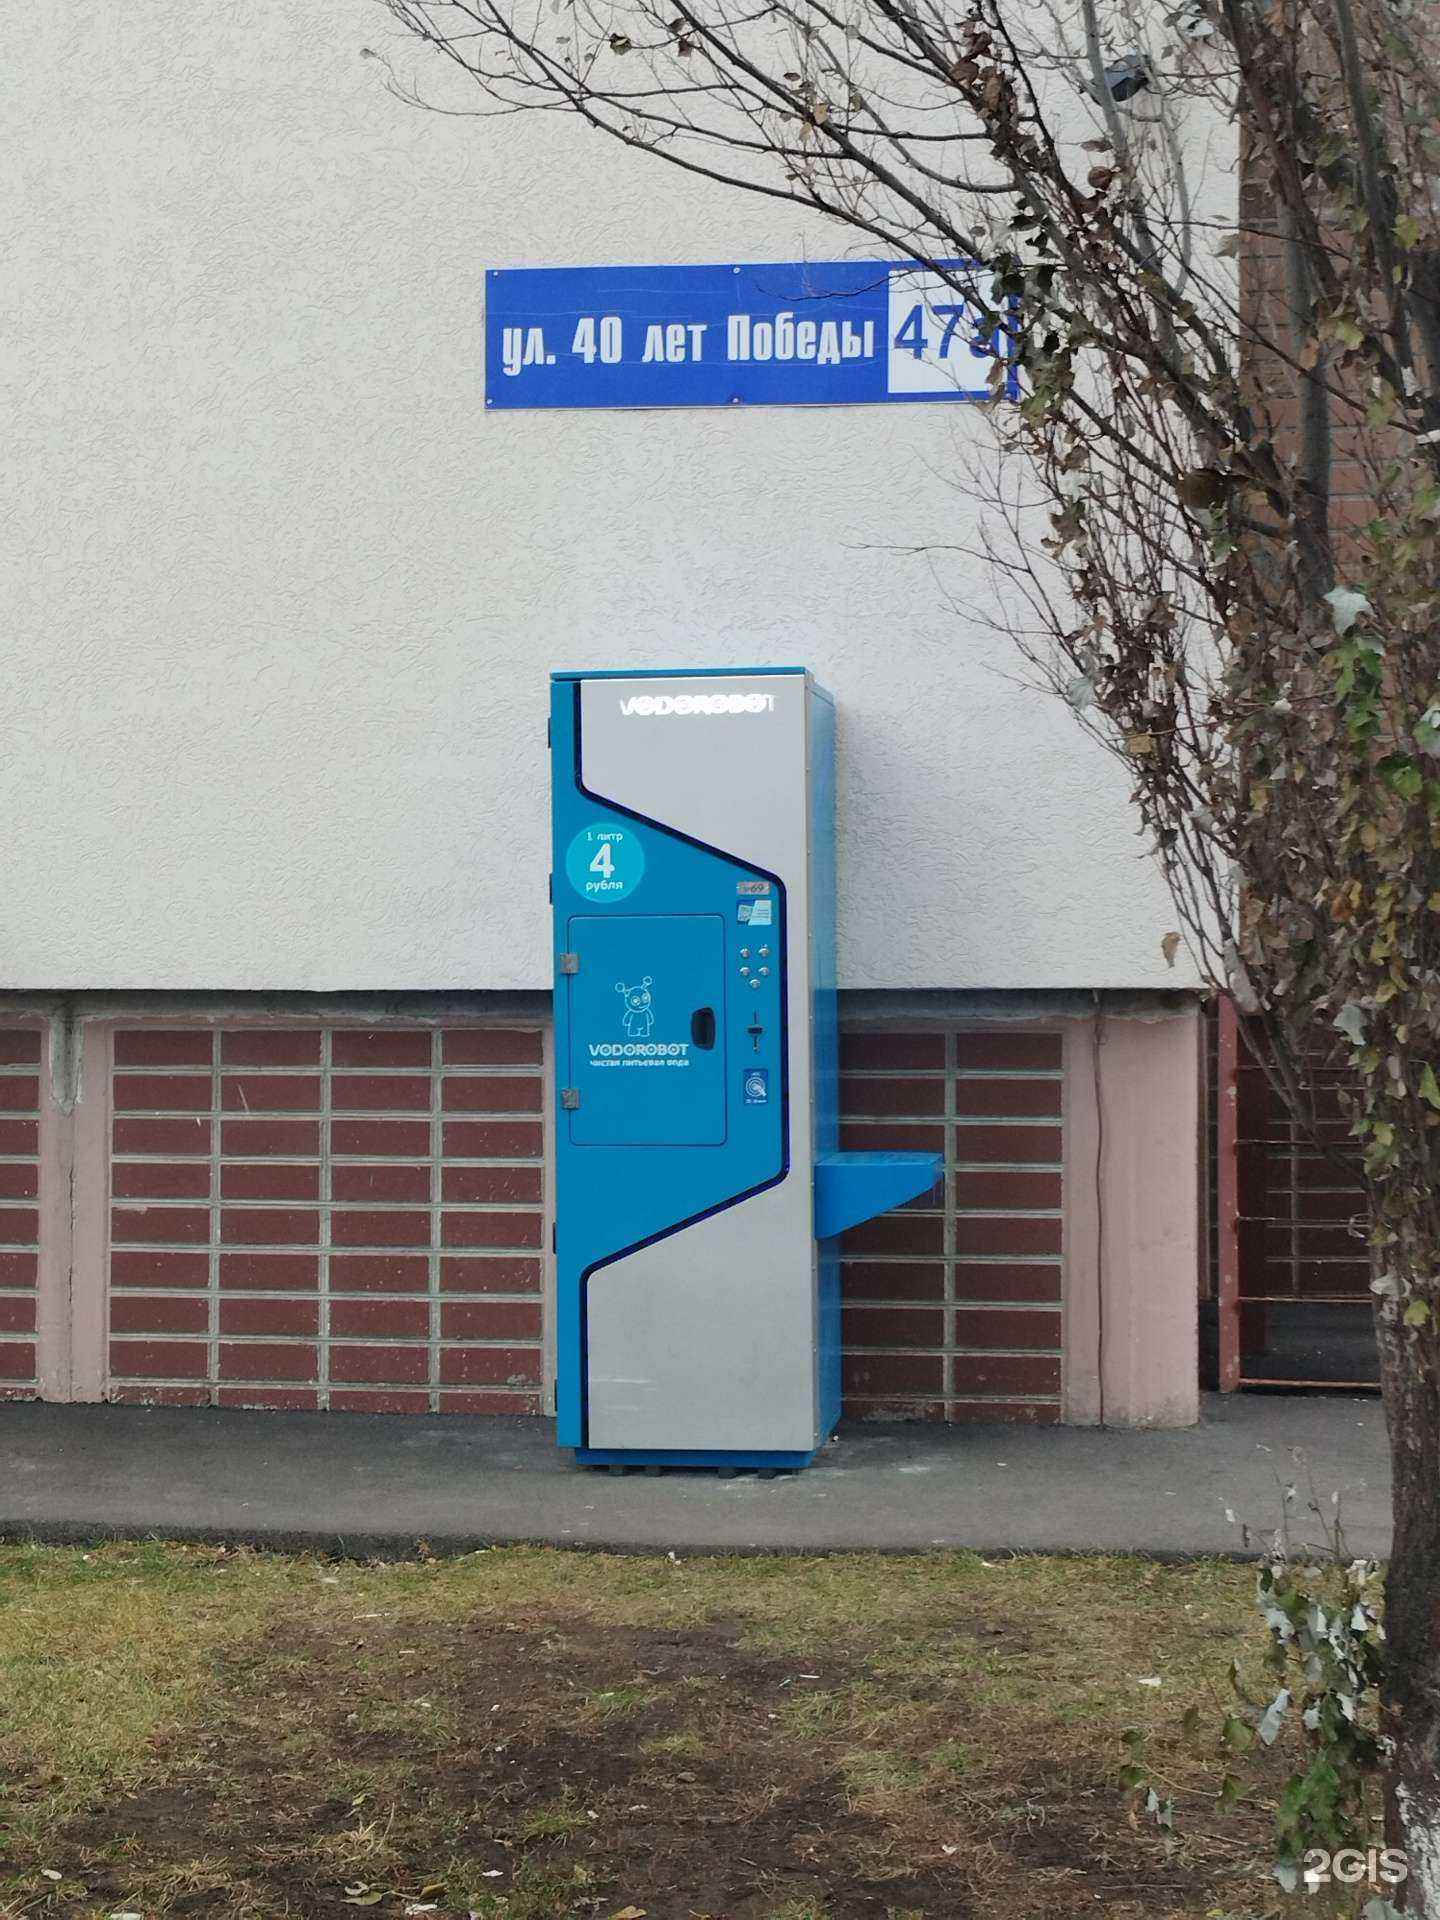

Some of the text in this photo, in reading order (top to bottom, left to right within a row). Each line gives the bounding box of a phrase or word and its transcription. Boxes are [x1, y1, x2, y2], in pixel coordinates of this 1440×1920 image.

[502, 326, 556, 376] ул.
[572, 316, 622, 364] 40
[641, 323, 708, 363] лет
[727, 312, 874, 364] Победы
[586, 832, 624, 843] 1 литр
[589, 843, 616, 879] 4
[585, 880, 624, 893] рубля
[588, 1043, 690, 1056] VODOROBOT
